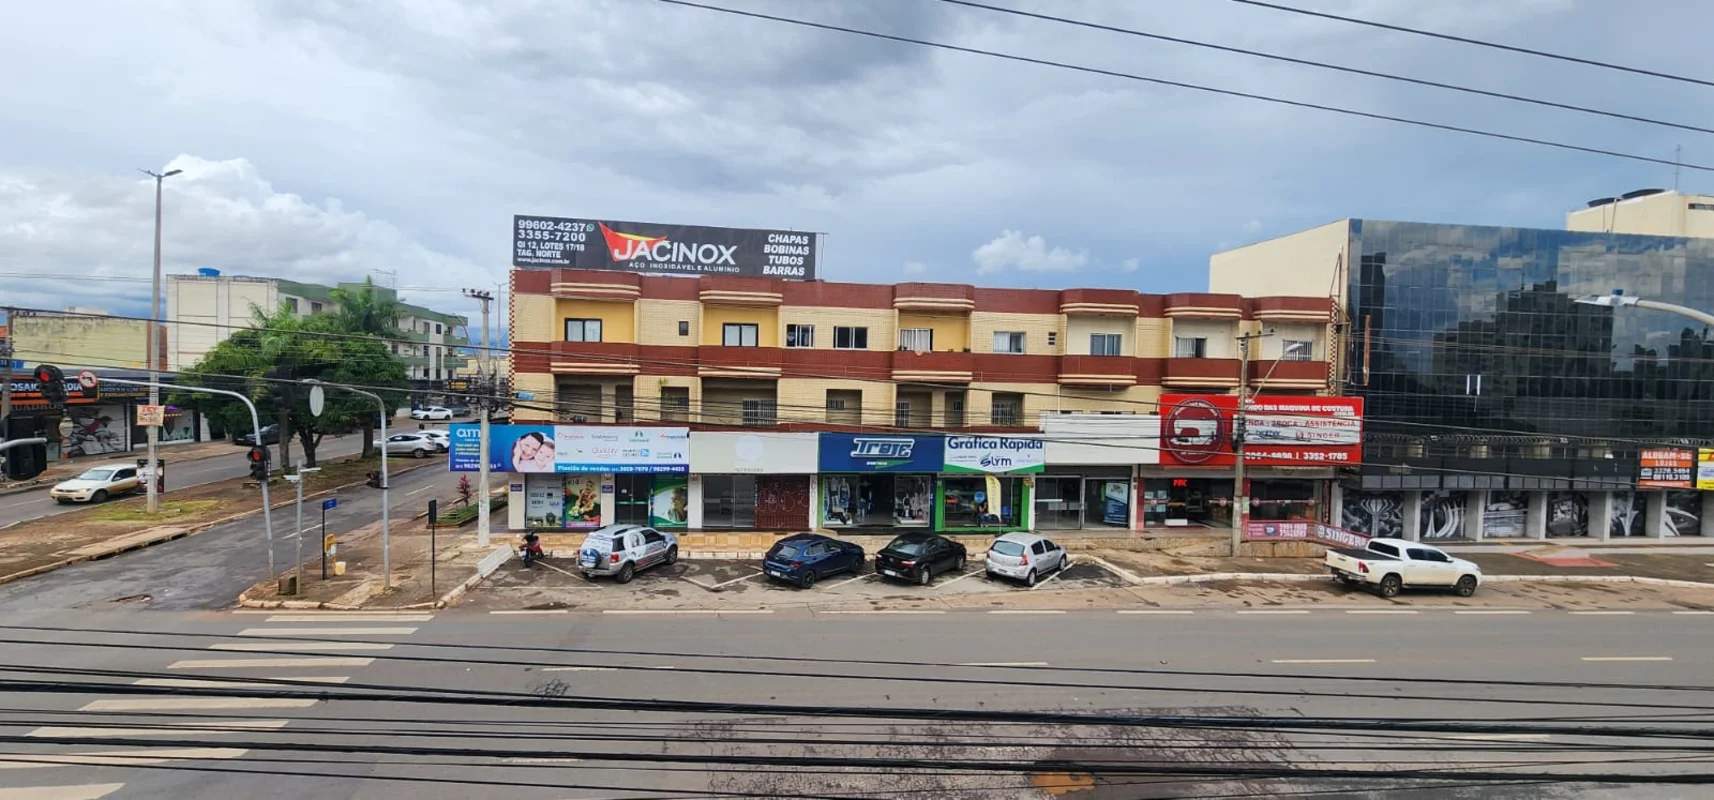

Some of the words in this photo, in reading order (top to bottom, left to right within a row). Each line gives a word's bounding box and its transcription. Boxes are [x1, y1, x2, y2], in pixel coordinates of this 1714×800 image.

[518, 220, 586, 232] 99602-4237
[518, 230, 586, 242] 3355-7200
[768, 233, 809, 245] CHAPAS
[540, 242, 564, 251] LOTES
[614, 239, 738, 265] JACINOX
[763, 244, 810, 255] BOBINAS
[536, 250, 561, 259] NORTE
[769, 255, 804, 265] TUBOS
[650, 262, 696, 271] INOXIDÁVEL
[763, 265, 805, 276] BARRAS
[1325, 526, 1362, 546] SINGER
